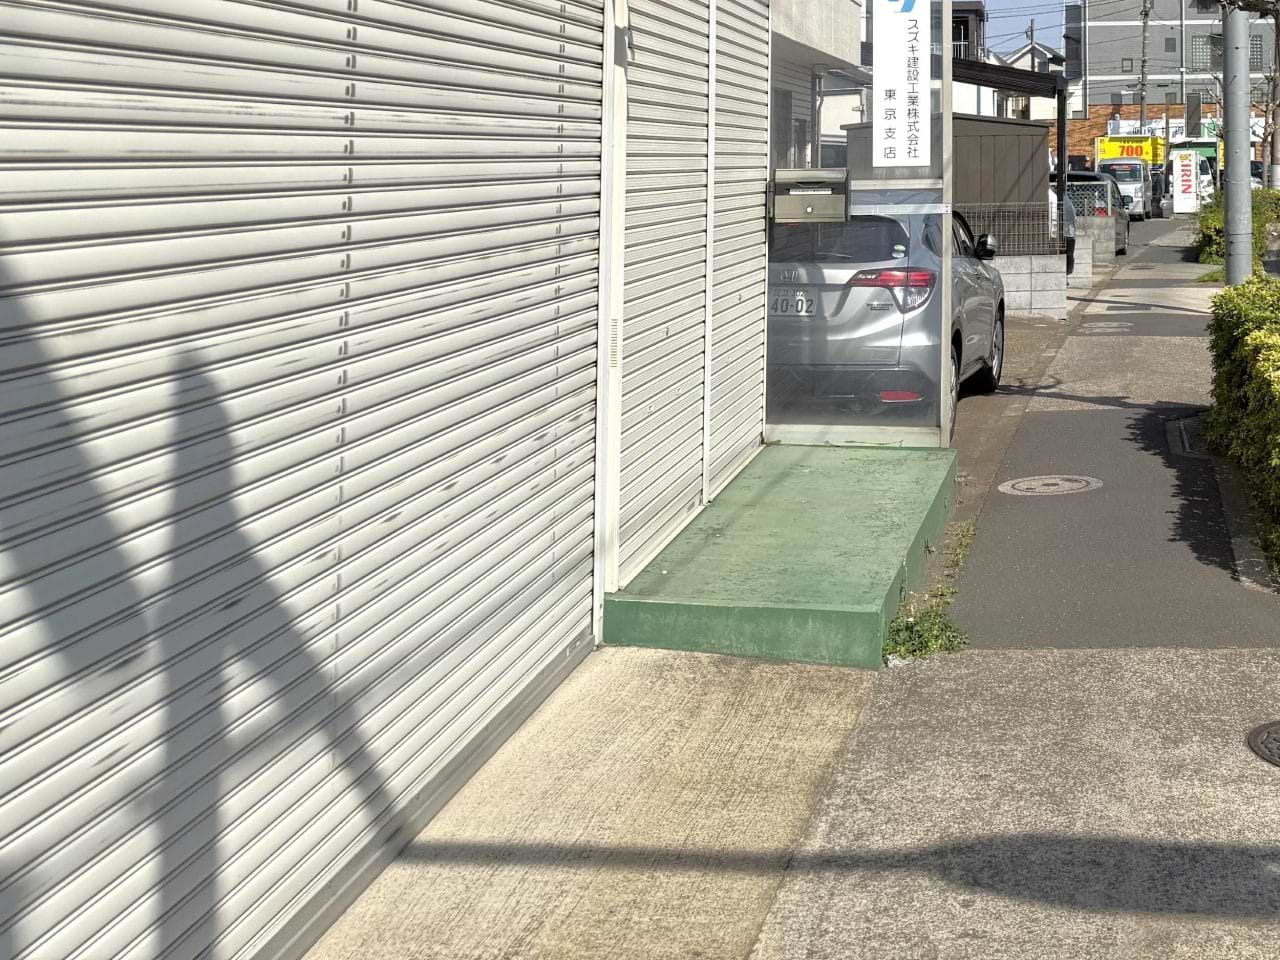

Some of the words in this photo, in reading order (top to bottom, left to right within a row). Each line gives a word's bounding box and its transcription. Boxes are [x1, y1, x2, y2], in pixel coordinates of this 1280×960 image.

[907, 19, 919, 158] スズキ建設工業株式会社
[883, 89, 896, 158] 東京支店
[1119, 145, 1143, 157] 700
[771, 298, 814, 313] 40-02
